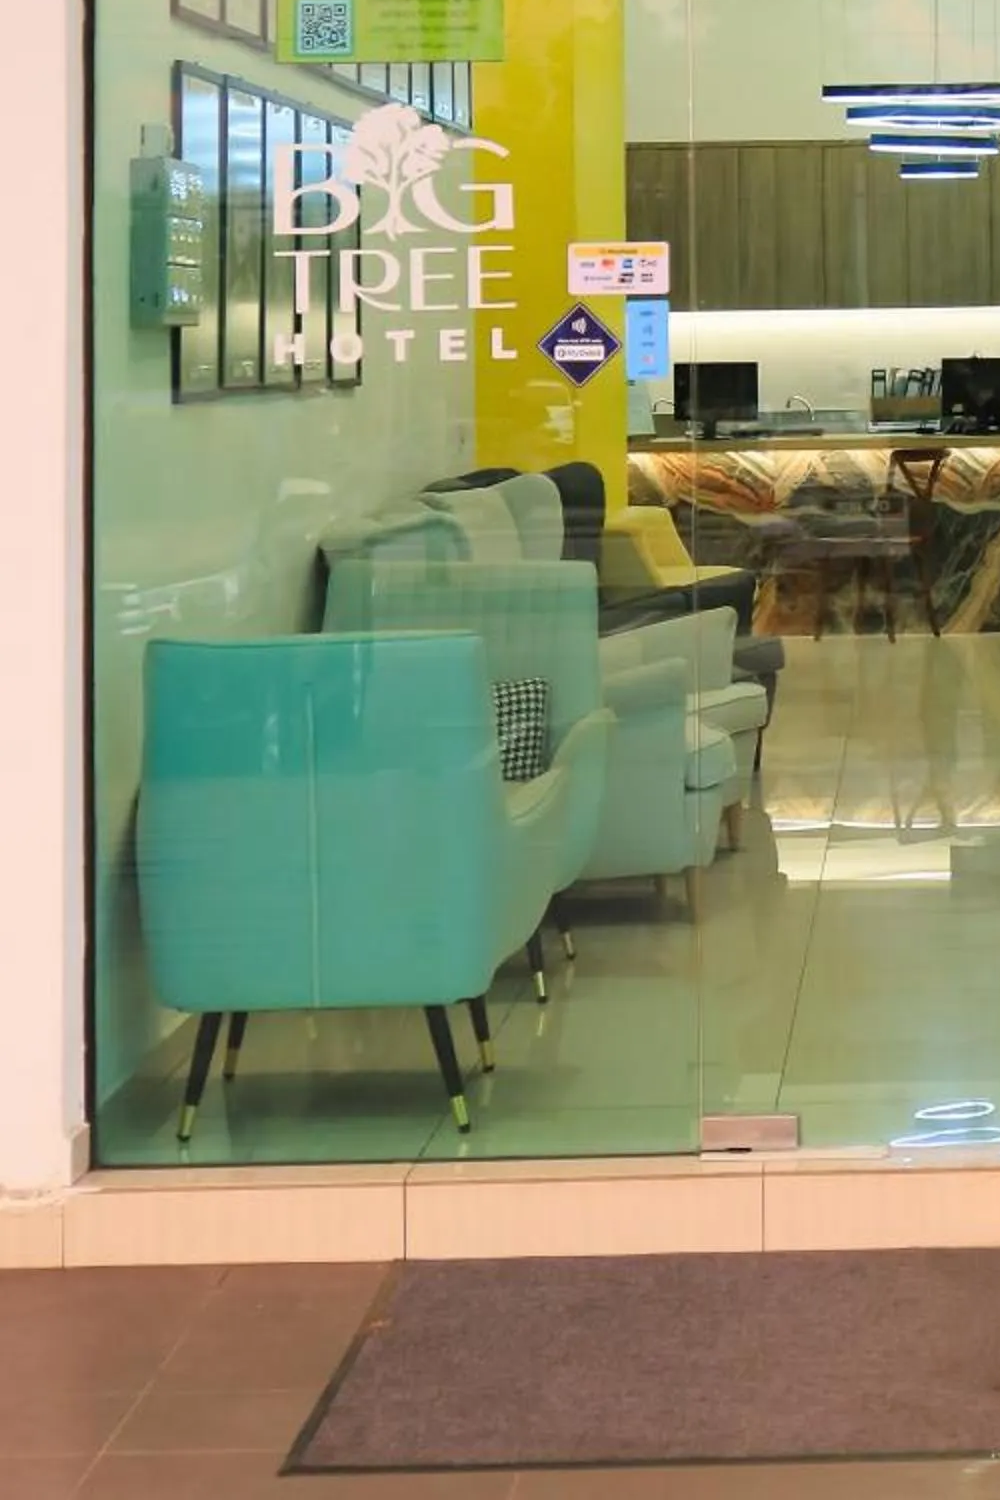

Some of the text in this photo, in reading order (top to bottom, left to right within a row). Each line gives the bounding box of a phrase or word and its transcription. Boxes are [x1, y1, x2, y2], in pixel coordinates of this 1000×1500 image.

[273, 136, 515, 238] BIG
[273, 245, 517, 314] TREE
[273, 327, 517, 366] HOTEL
